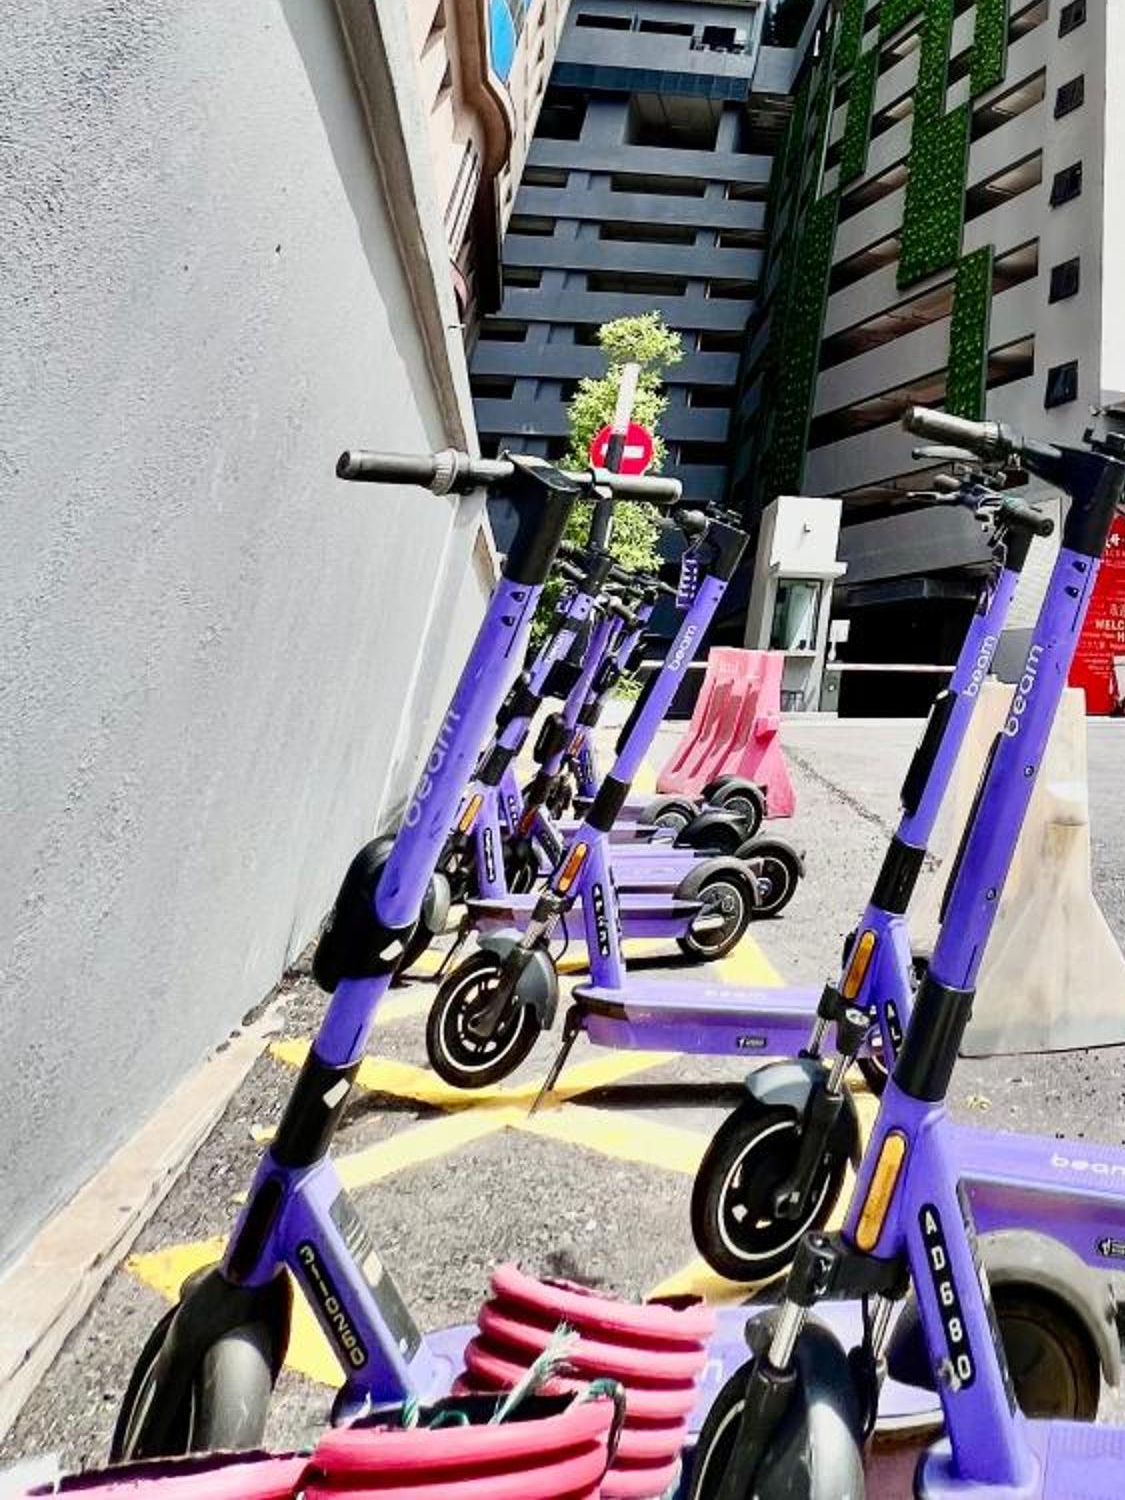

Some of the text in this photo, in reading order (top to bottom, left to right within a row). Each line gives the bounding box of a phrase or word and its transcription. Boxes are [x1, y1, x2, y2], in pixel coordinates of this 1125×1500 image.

[668, 625, 697, 671] beam
[962, 635, 999, 697] beam
[1004, 644, 1044, 737] beam
[924, 1211, 972, 1381] AD680
